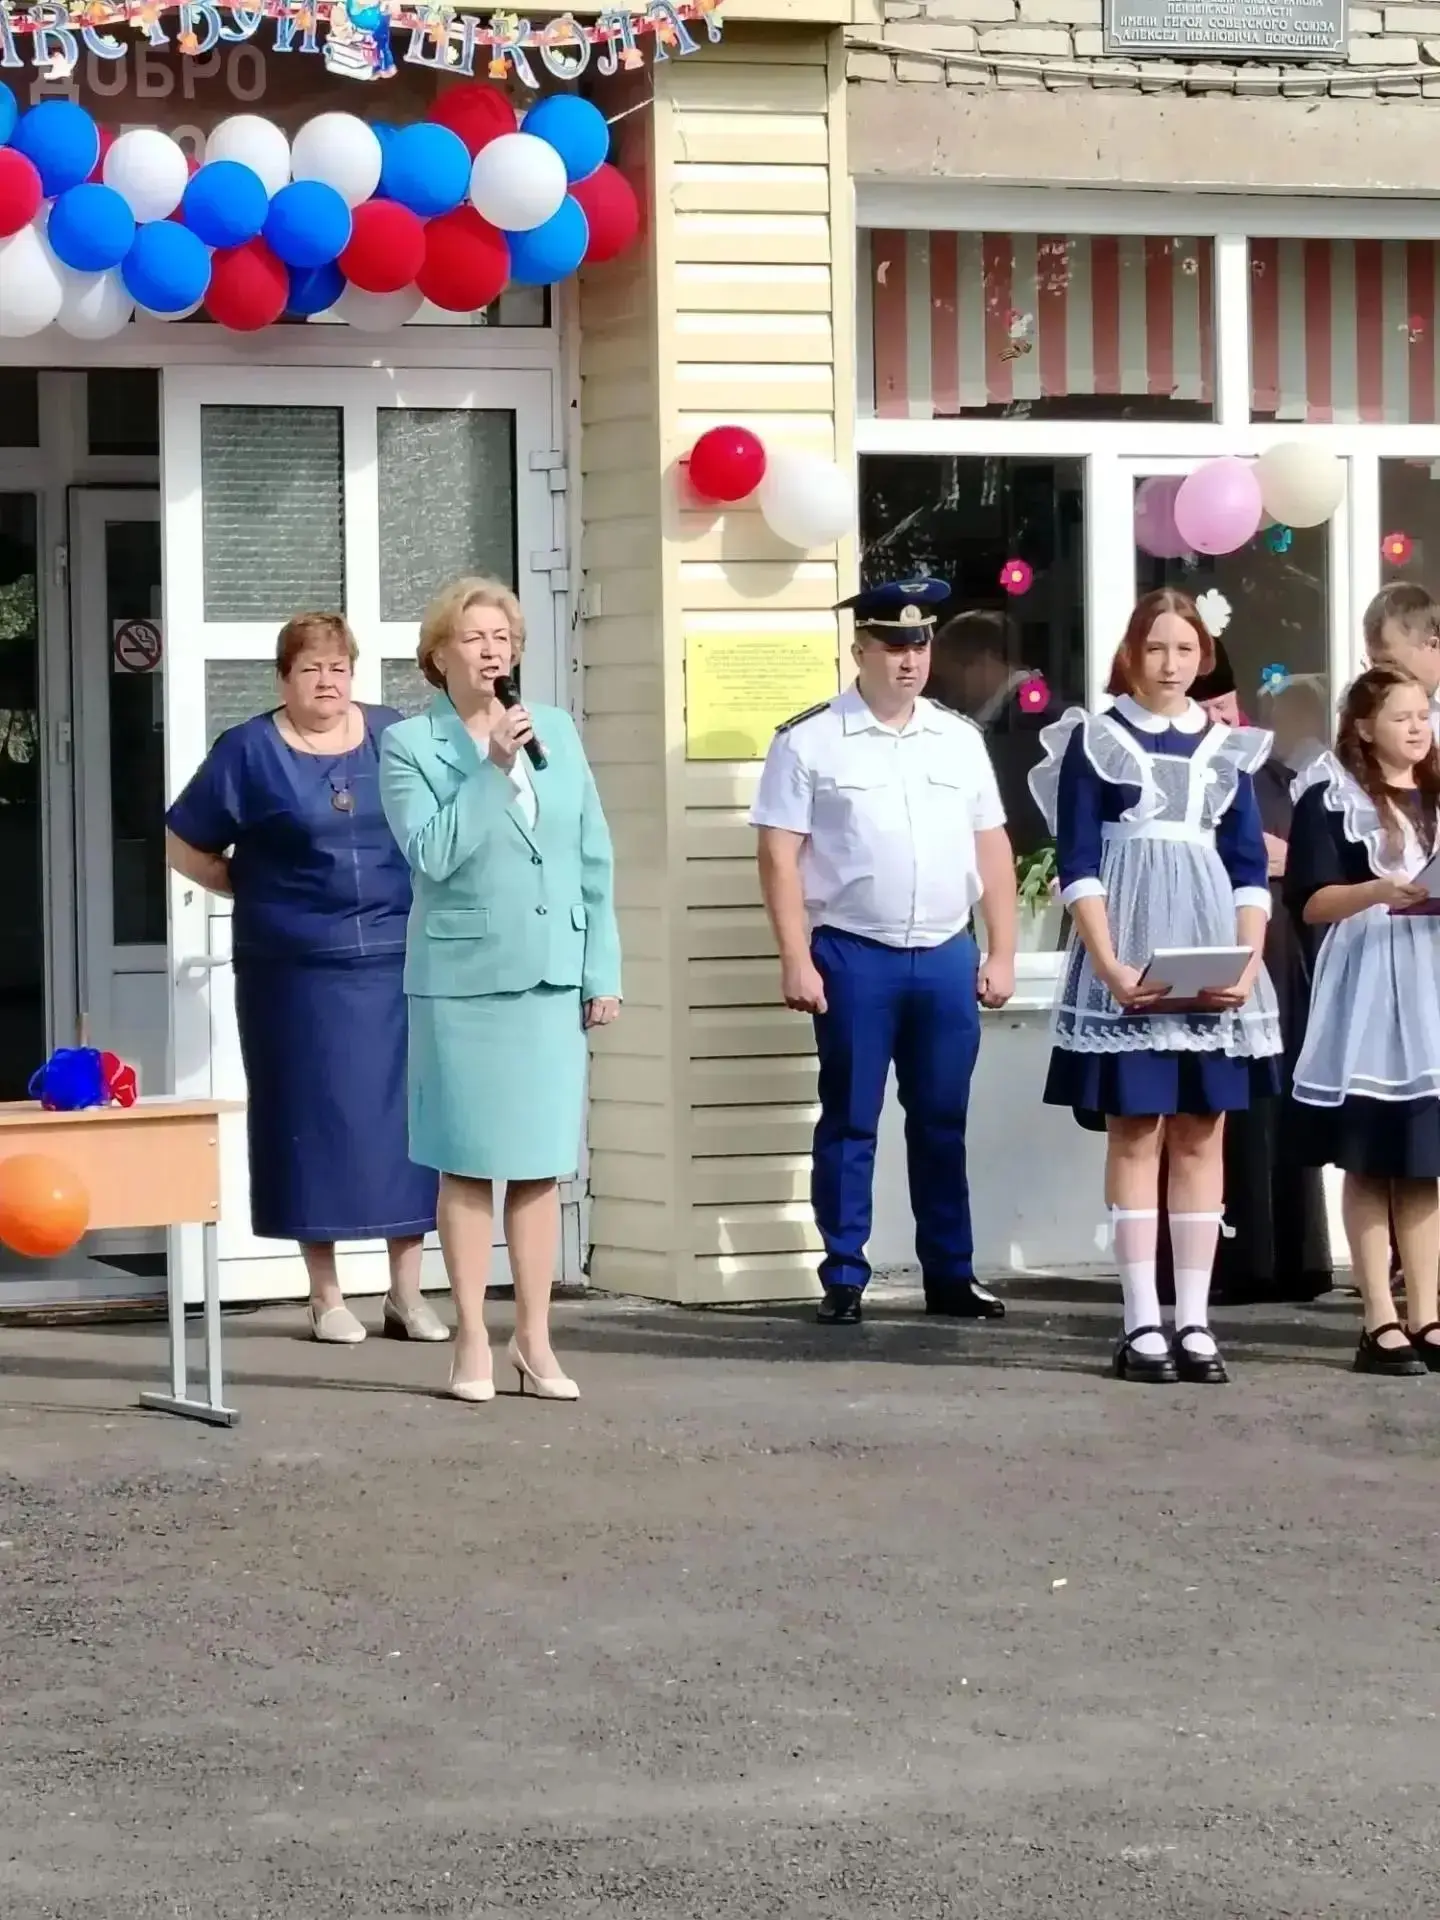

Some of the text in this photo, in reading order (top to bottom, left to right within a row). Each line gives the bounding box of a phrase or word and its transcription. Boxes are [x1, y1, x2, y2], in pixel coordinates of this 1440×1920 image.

[1244, 5, 1292, 16] ОБЛАСТИ
[1120, 15, 1335, 33] ИМЕНИ ГЕРОЯ СОВЕТСКОГО СОЮЗА
[1122, 28, 1330, 45] АЛЕКСЕЯ ИВАНОВИЧА БОРОДИНА
